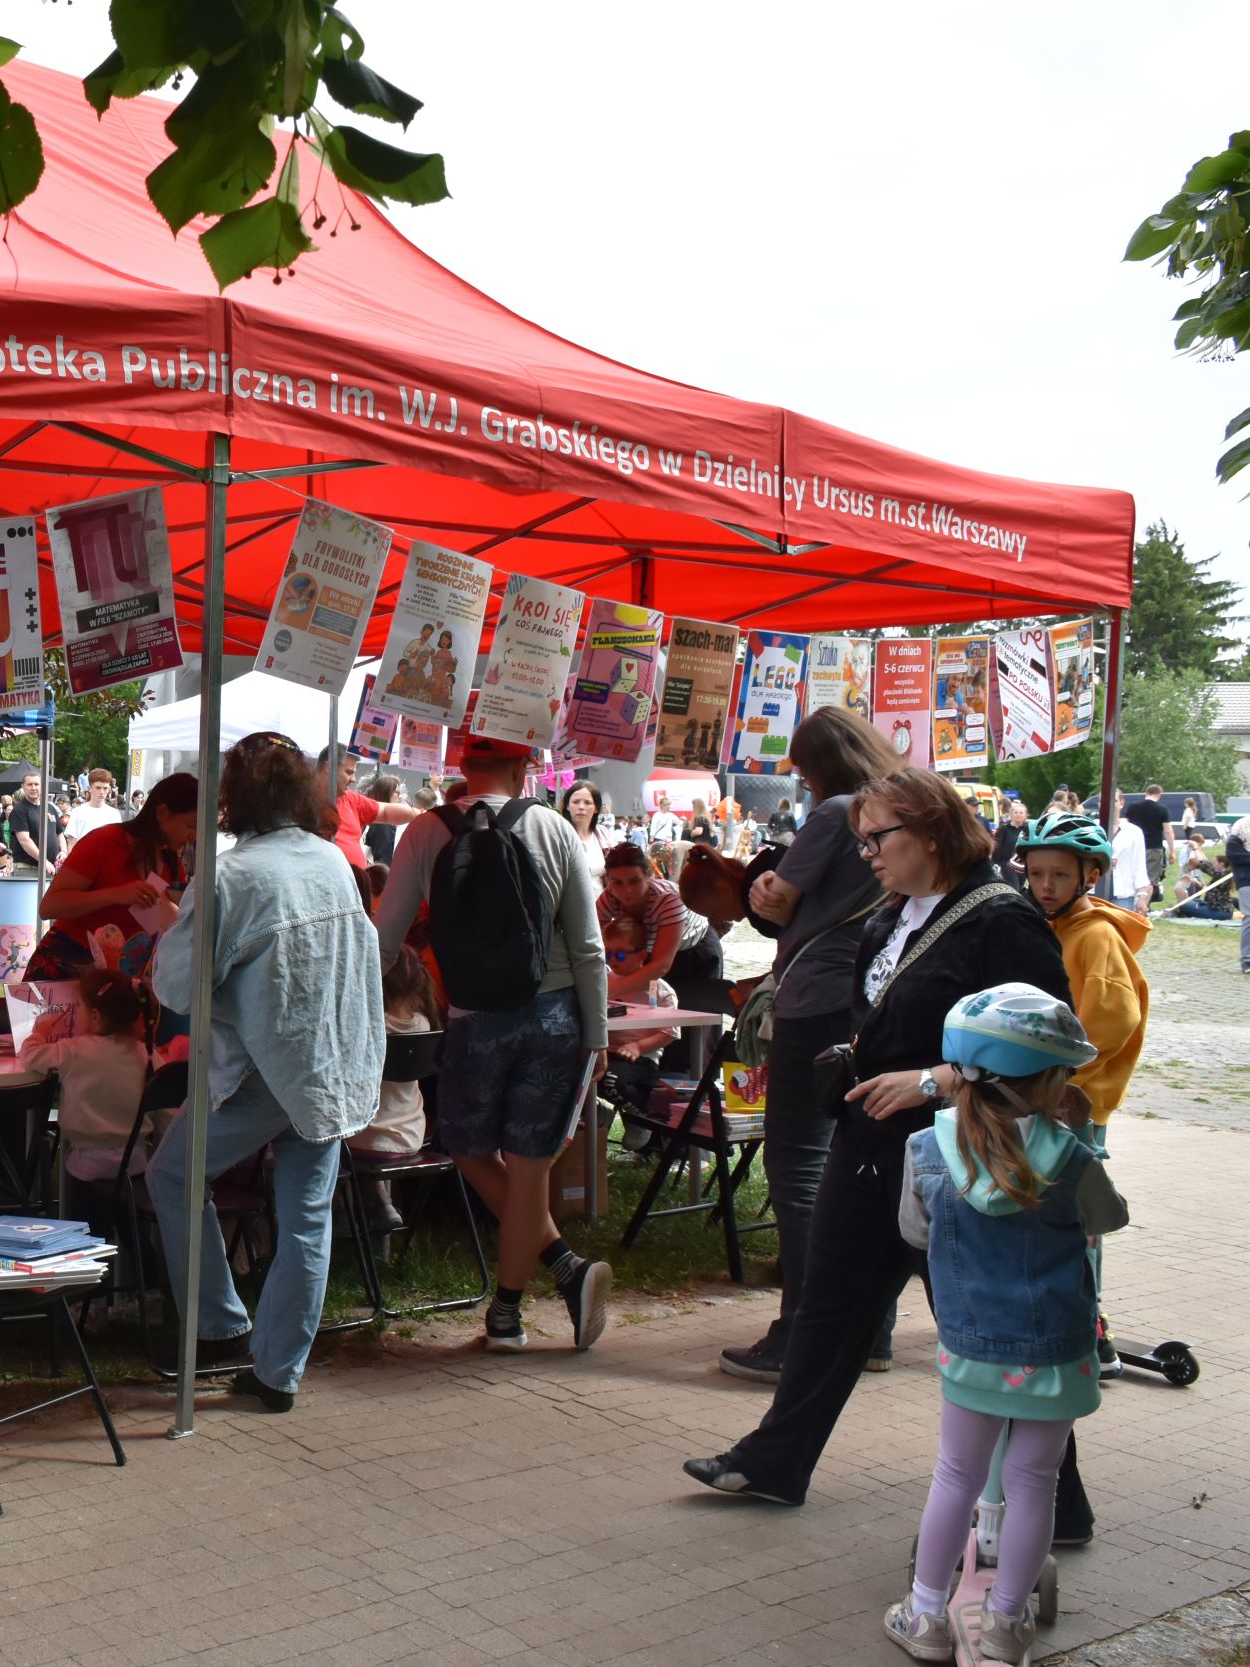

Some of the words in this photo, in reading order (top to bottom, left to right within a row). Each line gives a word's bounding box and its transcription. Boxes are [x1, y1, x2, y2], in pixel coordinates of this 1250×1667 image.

[121, 344, 317, 409] Publiczna
[330, 373, 386, 421] im.
[399, 386, 468, 436] W.J.
[480, 405, 650, 476] Grabskiego
[659, 448, 682, 477] w
[694, 450, 806, 511] Dzielnicy
[812, 477, 874, 518] Ursus
[314, 540, 367, 569] FRYWOLITKI
[301, 552, 320, 569] DLA
[321, 561, 371, 587] DOROSŁYCH
[95, 599, 140, 617] MATEMATYKA
[513, 594, 550, 621] KROI
[553, 607, 573, 633] SIĘ
[89, 620, 97, 628] W
[515, 619, 531, 630] COŚ
[531, 623, 564, 638] FAJNEGO
[674, 628, 735, 654] szach-mat
[889, 646, 898, 656] W
[898, 645, 921, 656] dniach
[999, 636, 1030, 665] rozmówki
[751, 663, 796, 690] LEGO
[884, 663, 897, 674] 5-6
[898, 664, 925, 673] czerwca
[1004, 651, 1039, 684] tematyczne
[1019, 681, 1044, 703] POLSKU
